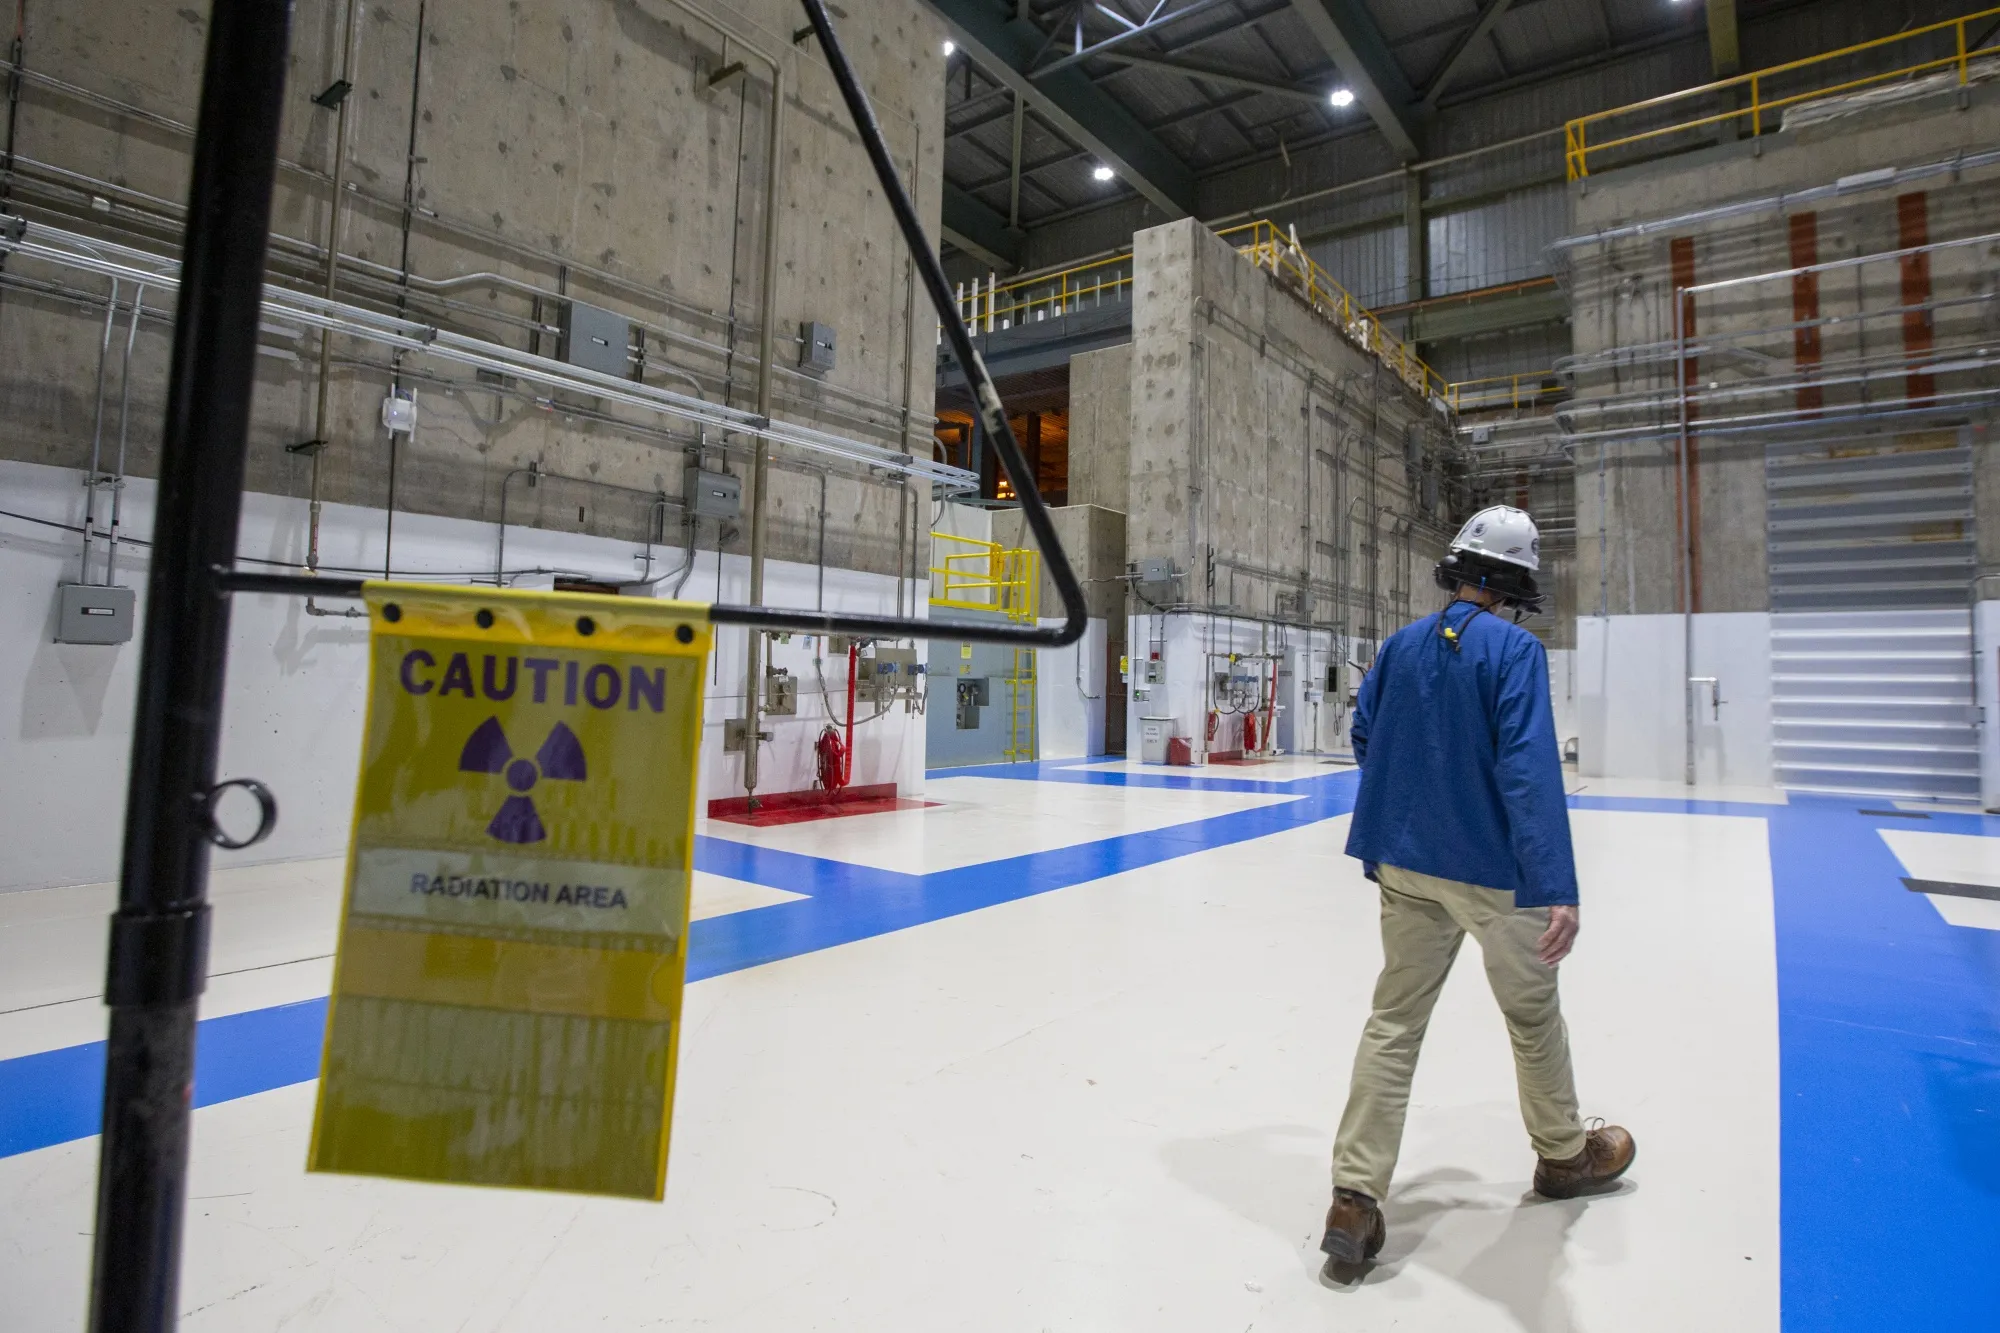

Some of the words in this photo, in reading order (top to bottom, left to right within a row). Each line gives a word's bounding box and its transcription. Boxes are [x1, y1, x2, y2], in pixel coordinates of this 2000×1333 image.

[400, 649, 666, 713] CAUTION
[410, 873, 550, 904] RADIATION
[554, 883, 628, 910] AREA
